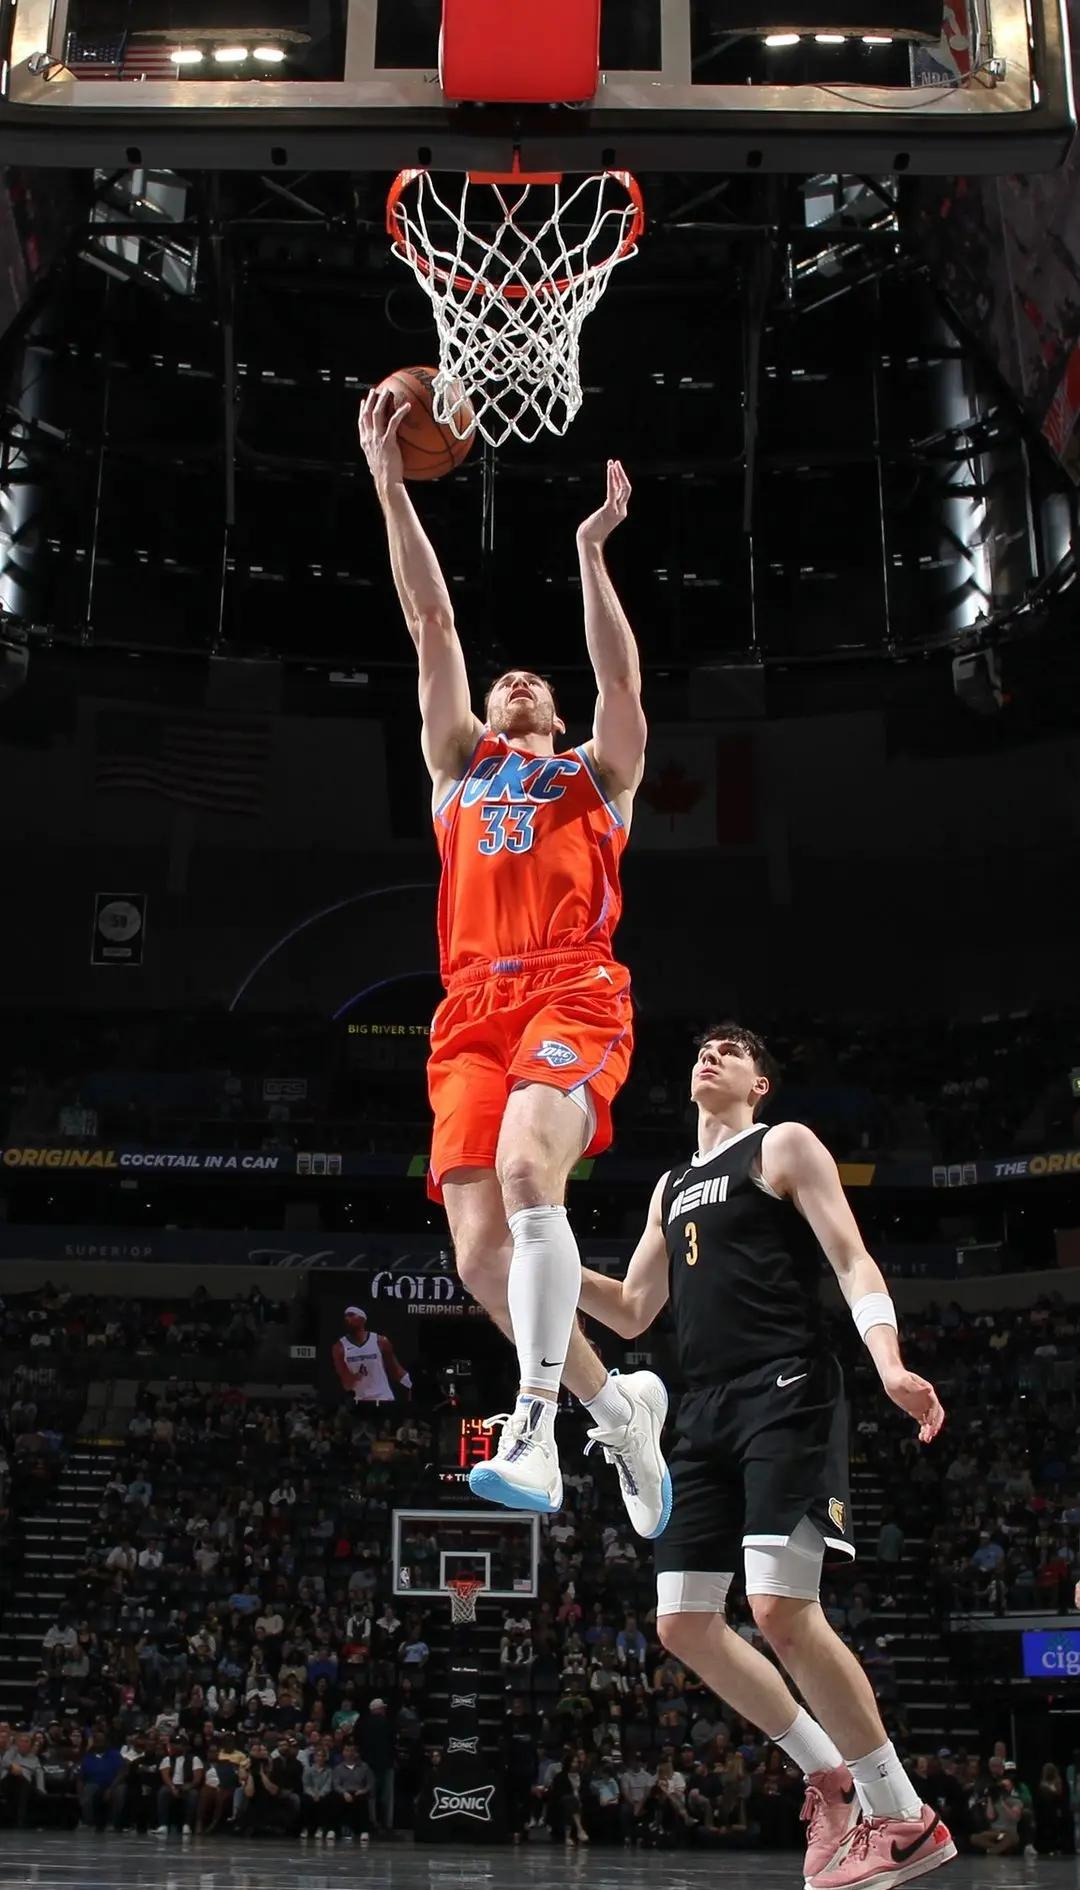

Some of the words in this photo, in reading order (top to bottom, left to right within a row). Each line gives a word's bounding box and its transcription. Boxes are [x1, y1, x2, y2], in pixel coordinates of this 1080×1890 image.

[460, 751, 581, 808] OKC
[478, 805, 537, 855] 33
[347, 1024, 368, 1034] BIG
[371, 1024, 405, 1035] RIVER
[3, 1149, 118, 1168] ORIGINAL
[120, 1154, 200, 1167] COCKTAIL
[204, 1155, 222, 1168] IN
[225, 1156, 237, 1168] A
[242, 1156, 279, 1169] CAN
[994, 1161, 1028, 1177] THE
[65, 1245, 152, 1256] SUPERIOR
[685, 1221, 699, 1267] 3
[371, 1271, 454, 1300] GOLD
[408, 1304, 463, 1314] MEMPHIS
[1041, 1645, 1080, 1675] cig
[438, 1796, 485, 1810] SONIC
